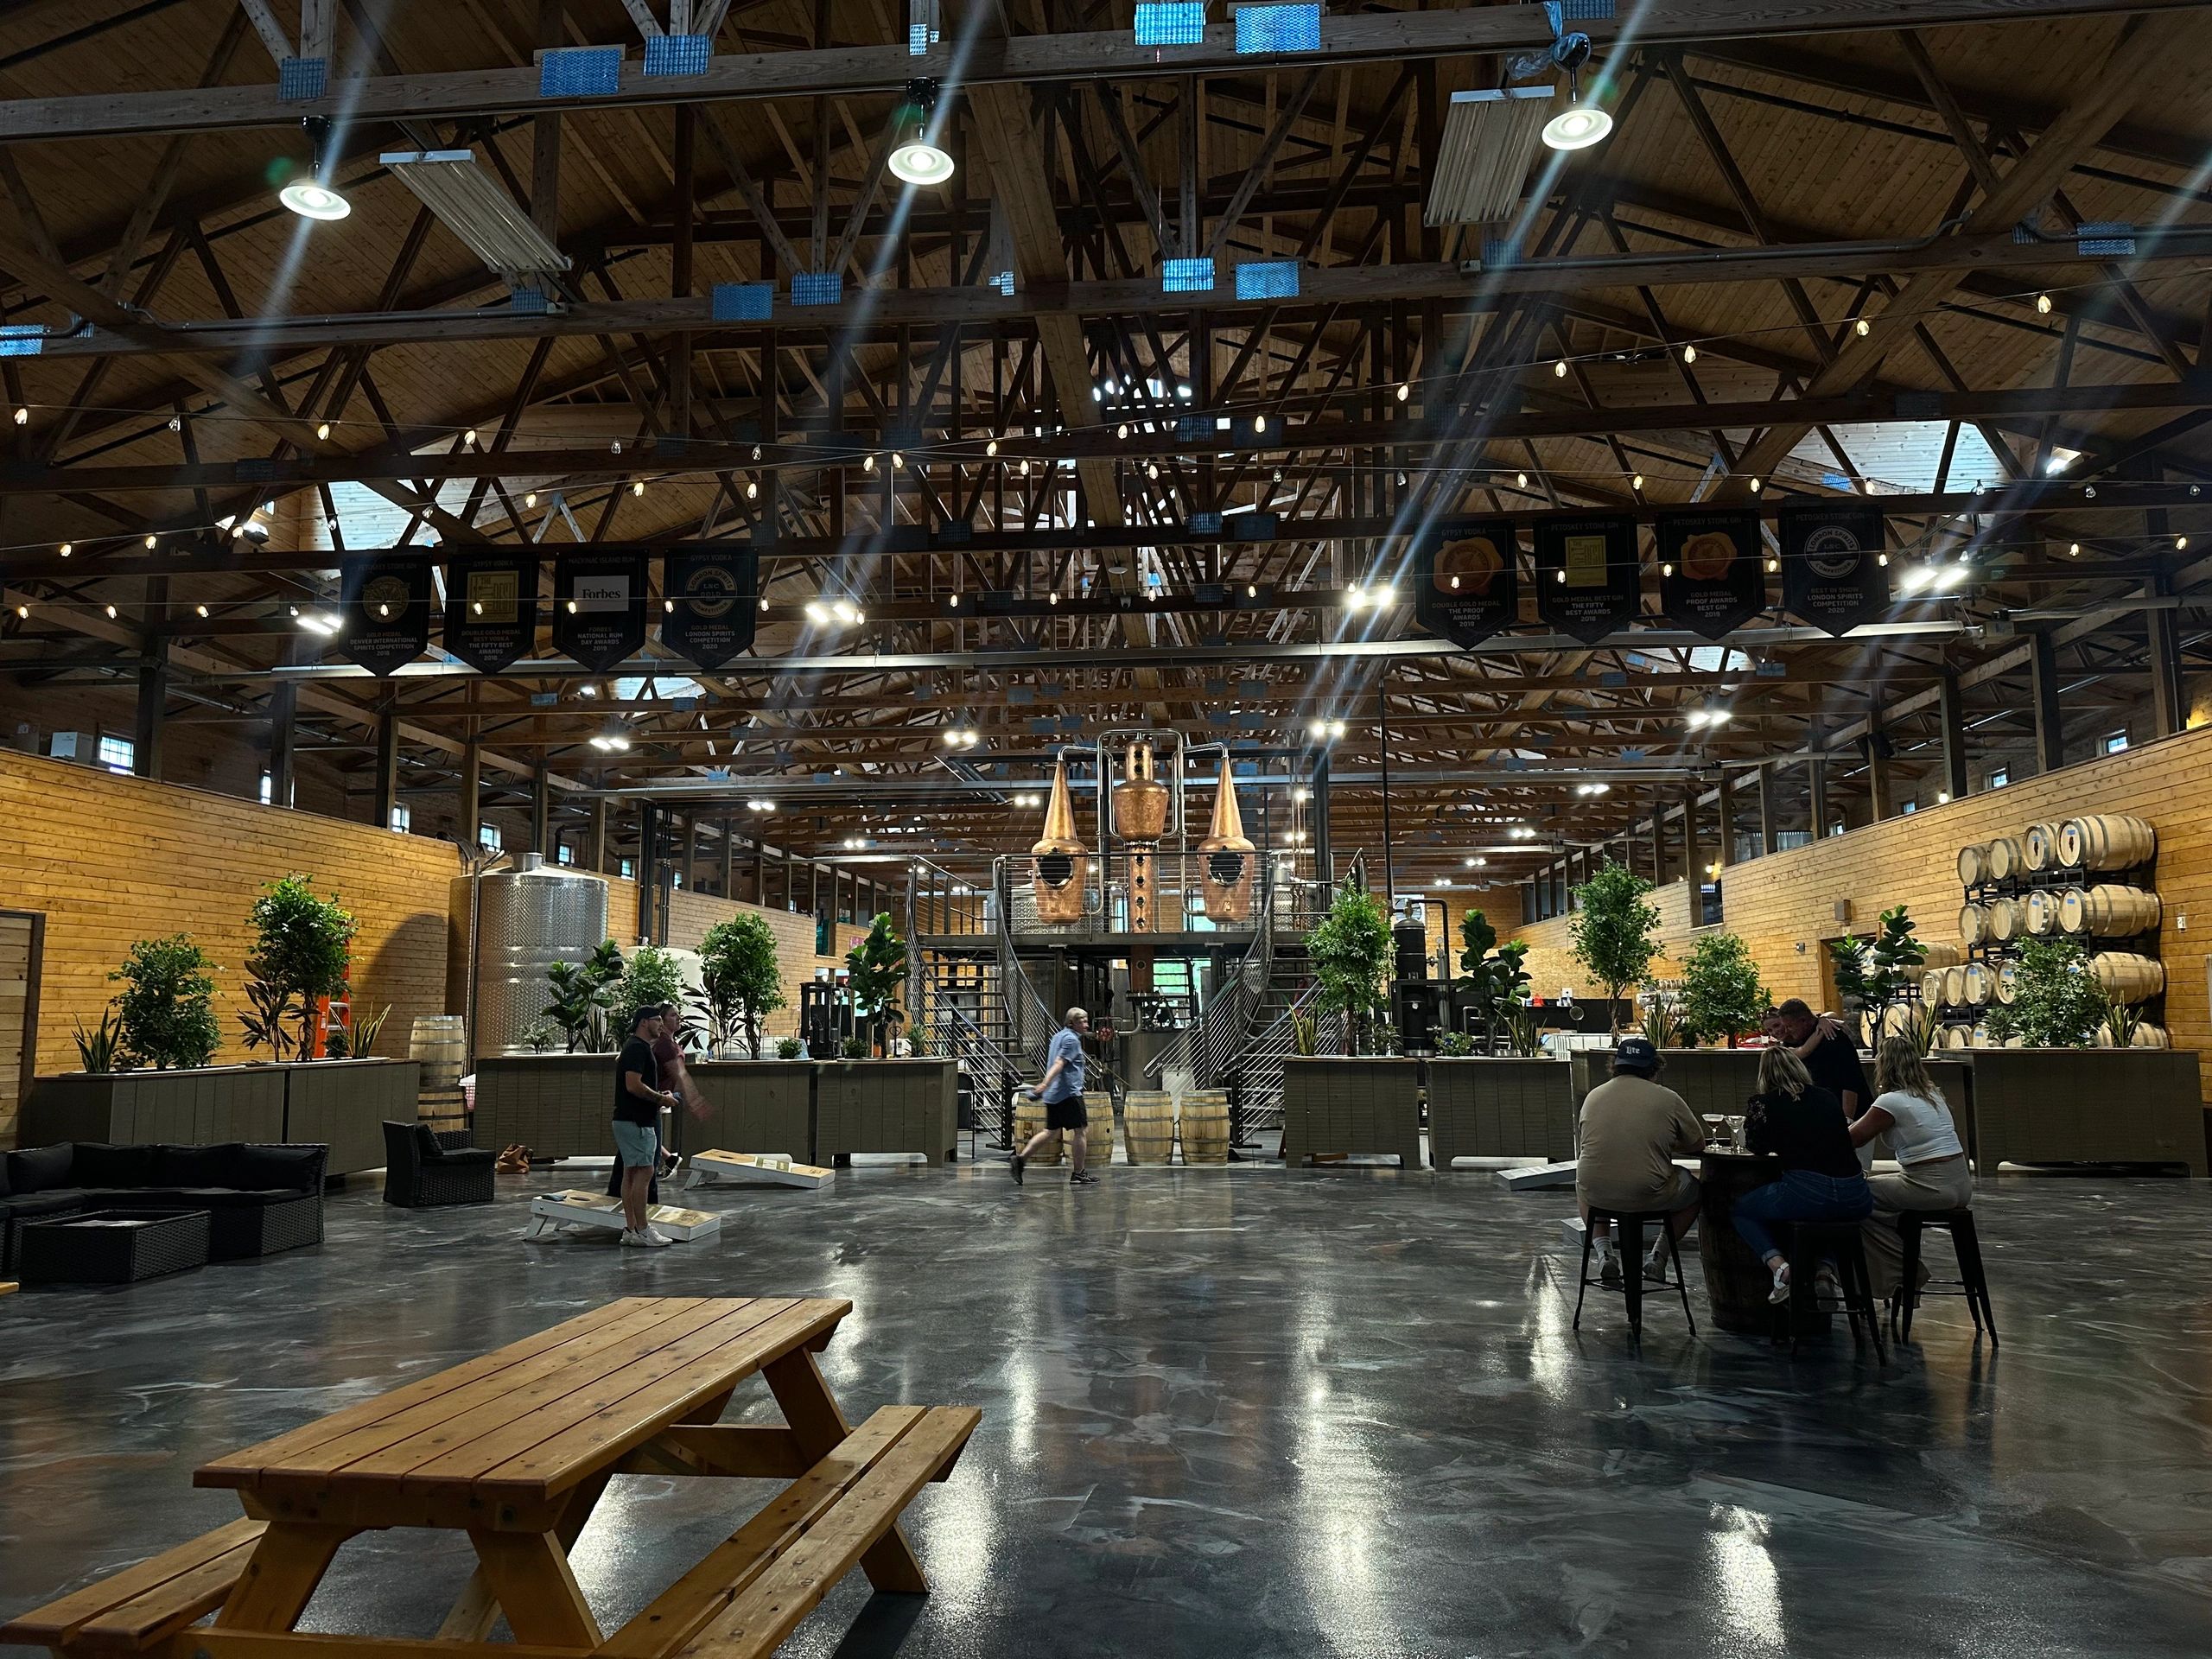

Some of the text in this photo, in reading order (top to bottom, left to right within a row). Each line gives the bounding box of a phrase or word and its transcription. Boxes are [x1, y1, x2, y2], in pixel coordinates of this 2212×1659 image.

[1810, 531, 1854, 550] LONDON SPIRITS
[1815, 563, 1852, 573] COMPETITION
[690, 569, 734, 589] LONDON SPIRITS
[582, 588, 621, 599] Forbes
